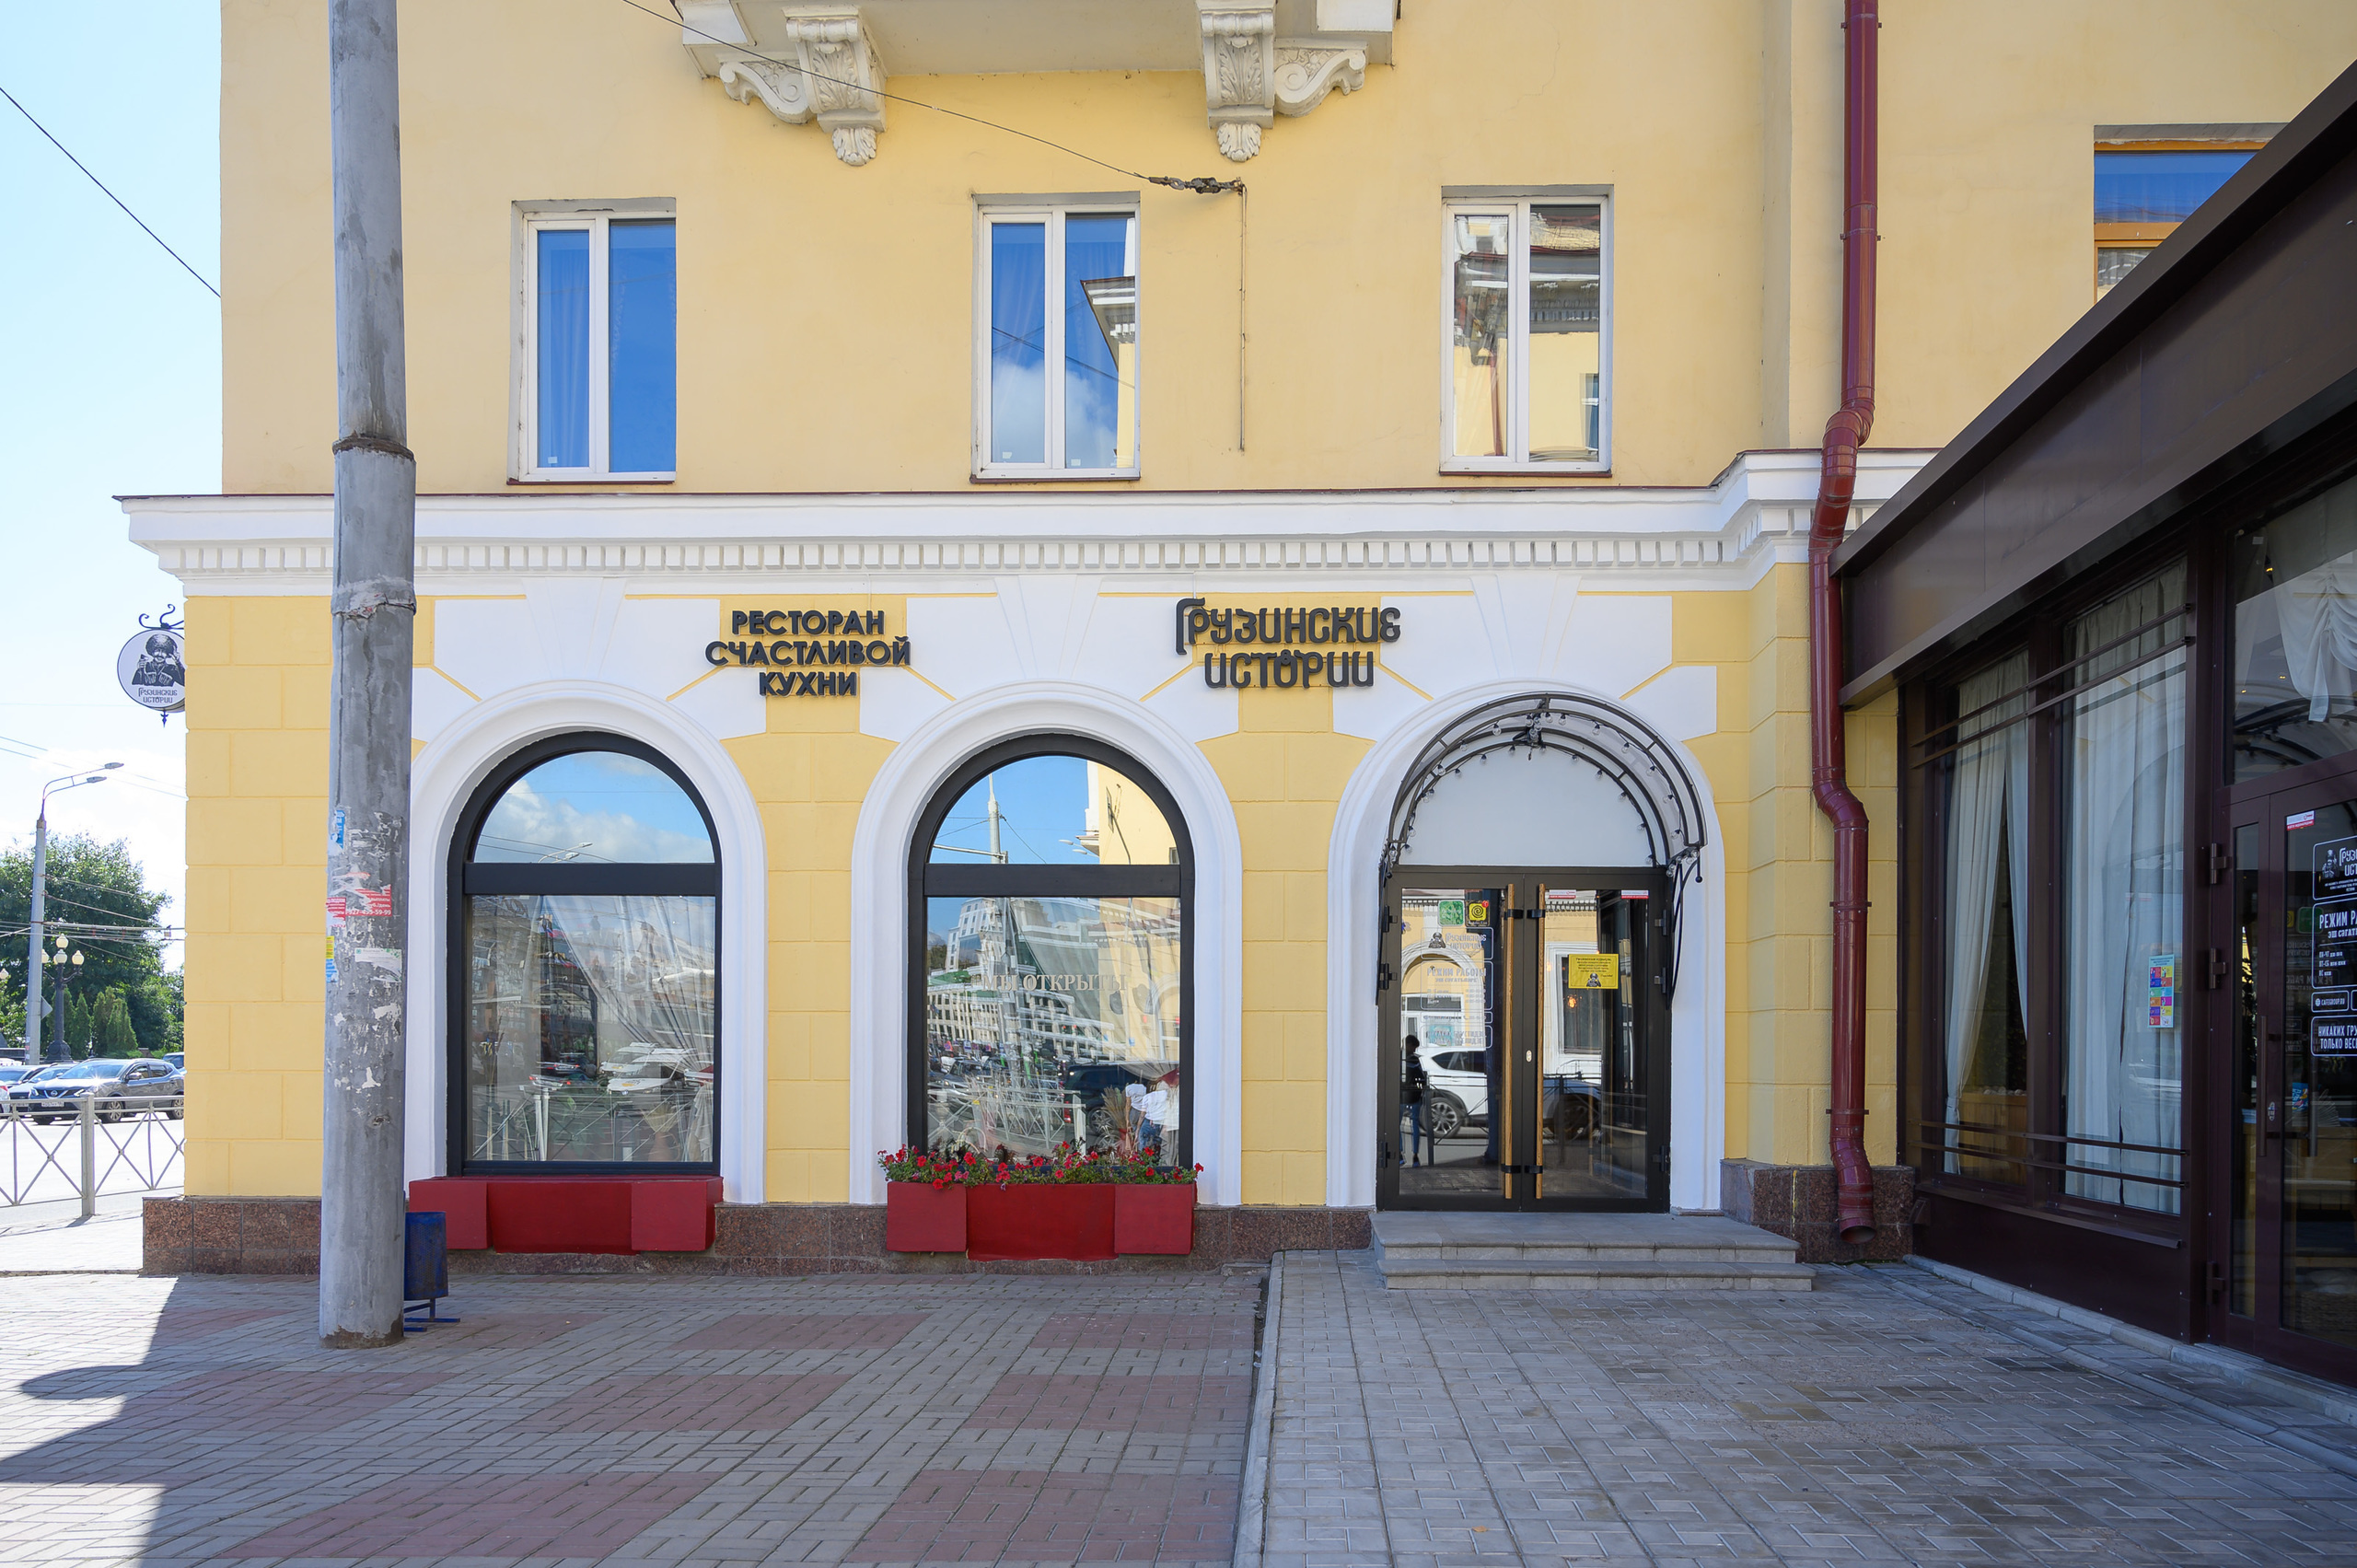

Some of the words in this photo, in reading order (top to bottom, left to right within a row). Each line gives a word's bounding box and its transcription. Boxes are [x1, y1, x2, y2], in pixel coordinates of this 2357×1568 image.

[732, 610, 885, 635] РЕСТОРАН
[705, 636, 911, 666] СЧАСТЛИВОЙ
[1204, 649, 1375, 689] ИСТОРИИ
[759, 671, 858, 697] КУХНИ
[2319, 911, 2348, 930] РЕЖИМ
[982, 974, 1020, 992] МЫ
[1022, 974, 1127, 992] ОТКРЫТЫ
[2320, 1039, 2343, 1050] ТОЛЬКО
